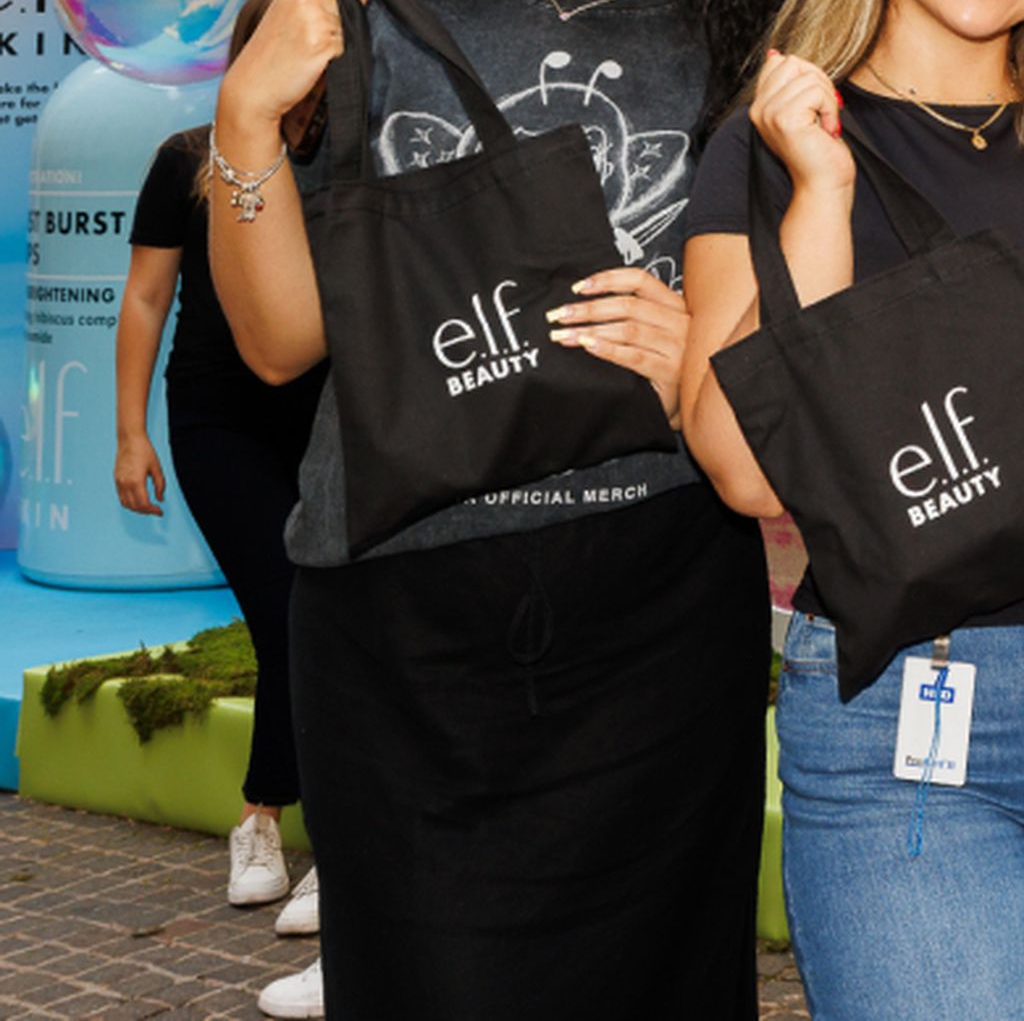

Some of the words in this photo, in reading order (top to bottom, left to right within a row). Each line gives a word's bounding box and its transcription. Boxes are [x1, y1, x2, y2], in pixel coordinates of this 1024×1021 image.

[46, 210, 126, 236] BURST
[446, 347, 540, 397] BEAUTY
[484, 489, 576, 506] OFFICIAL
[582, 482, 649, 504] MERCH
[906, 465, 1001, 528] BEAUTY
